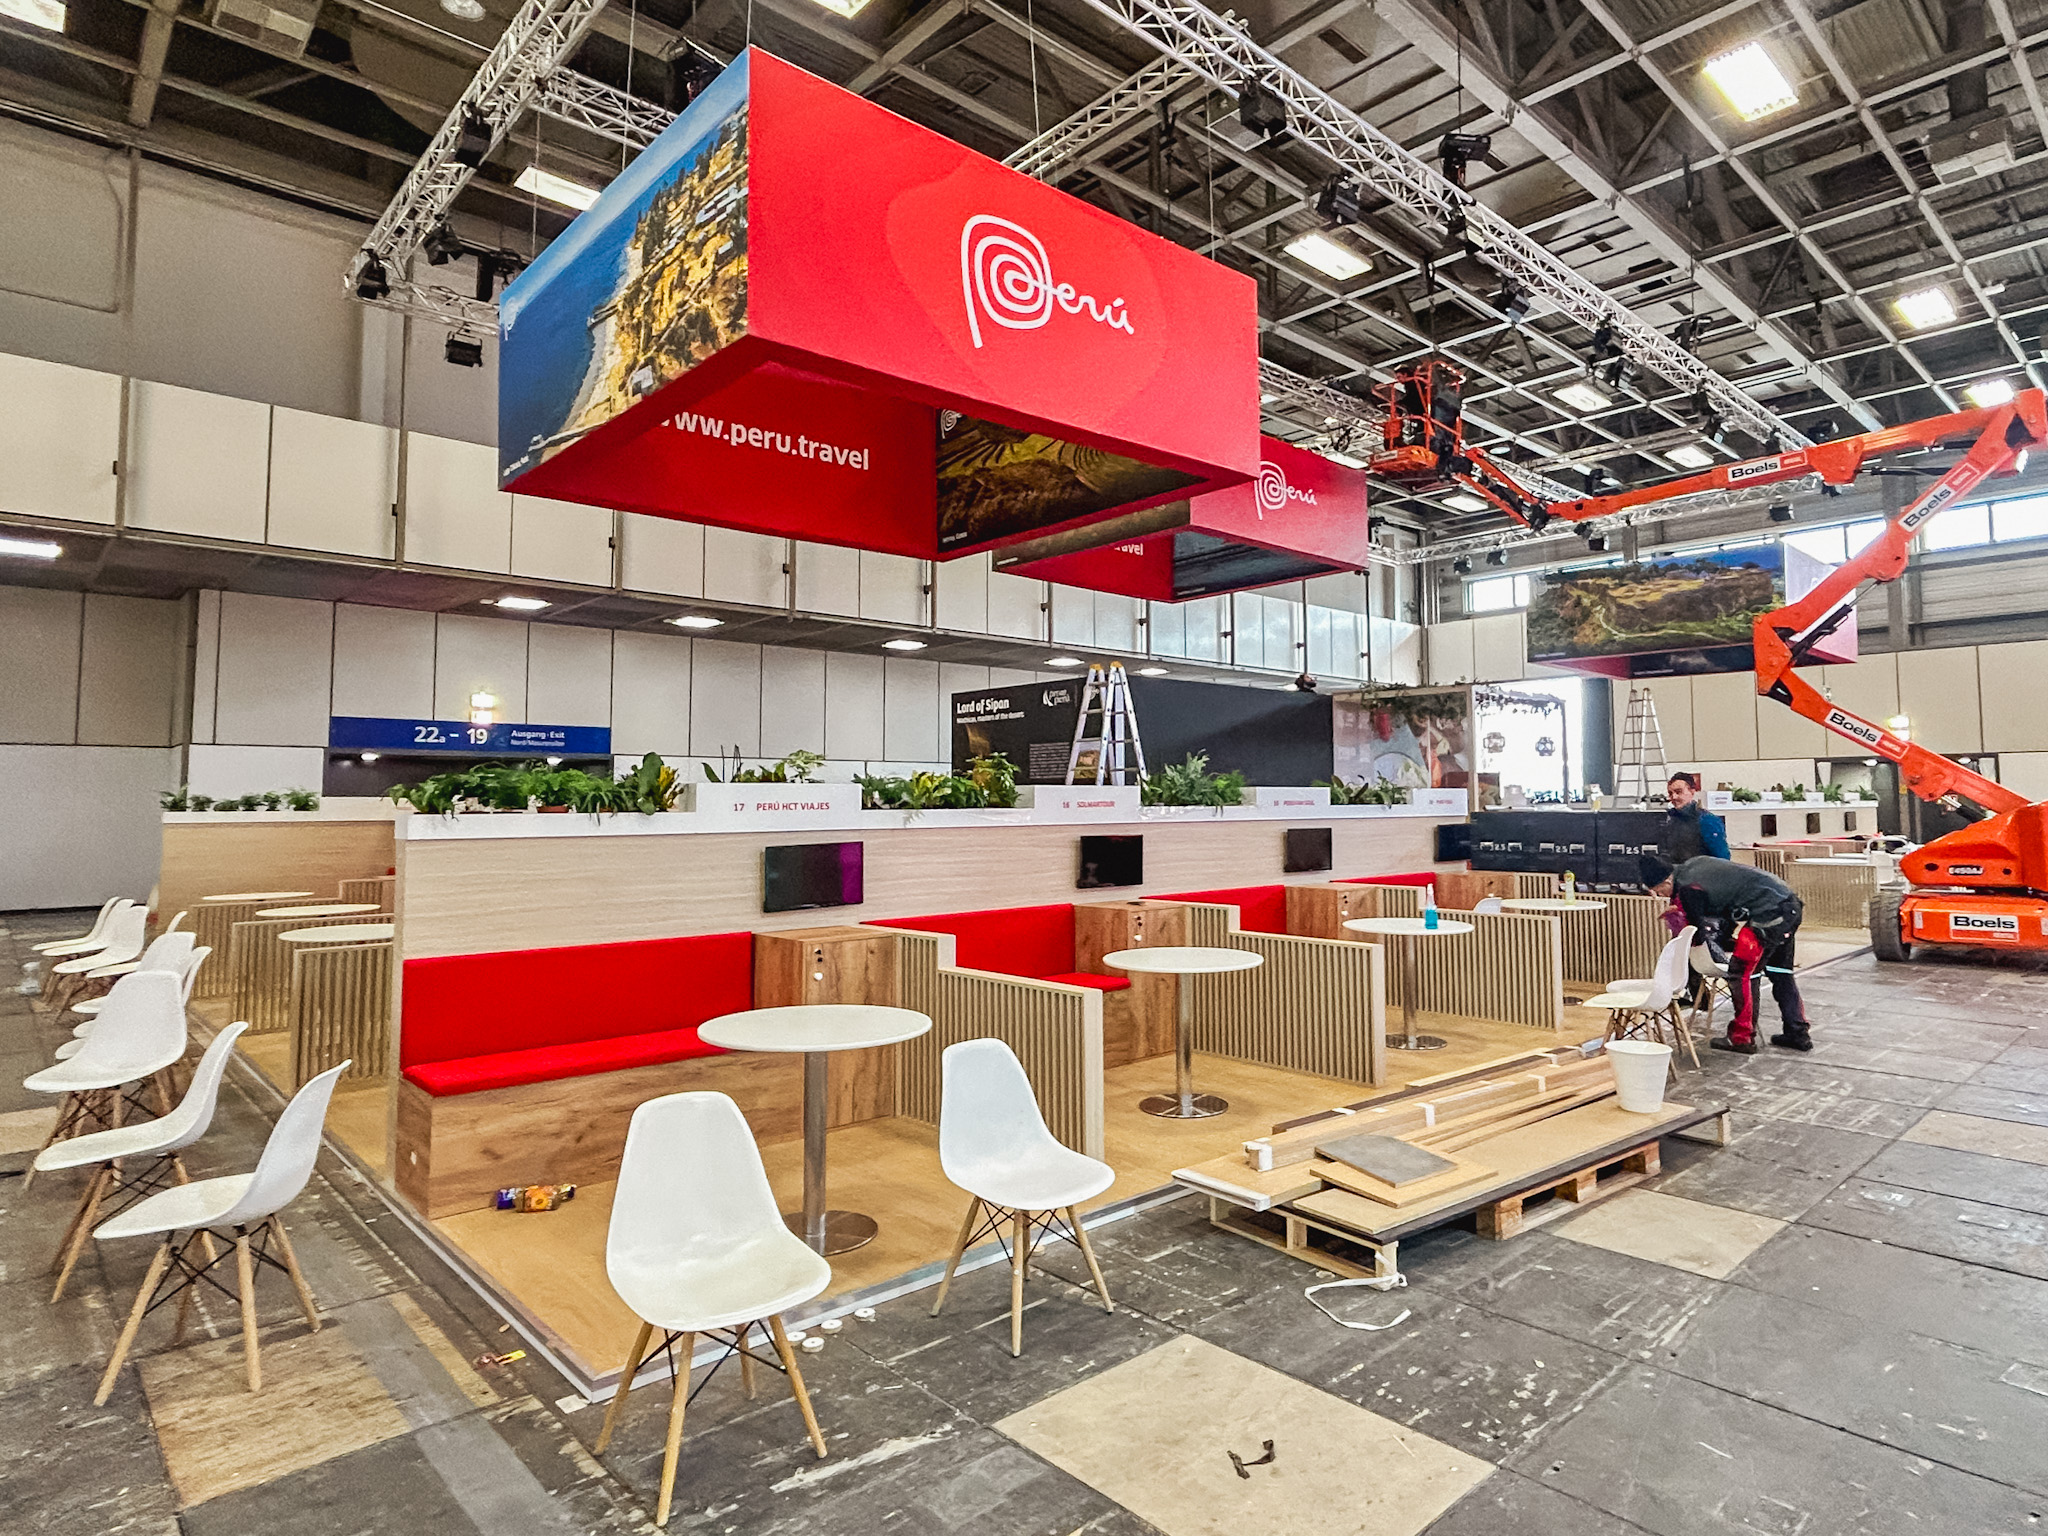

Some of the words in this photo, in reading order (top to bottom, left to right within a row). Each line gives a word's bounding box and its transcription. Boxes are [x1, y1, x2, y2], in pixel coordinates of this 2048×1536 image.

[960, 213, 1135, 349] Perú
[661, 411, 869, 470] ww.peru.travel
[1731, 462, 1778, 478] Boels
[1903, 488, 1951, 527] Boels
[956, 701, 975, 714] Lord
[976, 699, 985, 714] of
[985, 698, 1010, 713] Sipan
[414, 726, 446, 743] 22a
[466, 728, 488, 744] 19
[511, 730, 546, 739] Ausgang
[1829, 712, 1878, 742] Boels
[733, 803, 745, 811] 17
[756, 801, 780, 811] PERÚ
[782, 802, 799, 811] HCT
[800, 802, 830, 810] VIAJES
[1953, 915, 2015, 929] Boels
